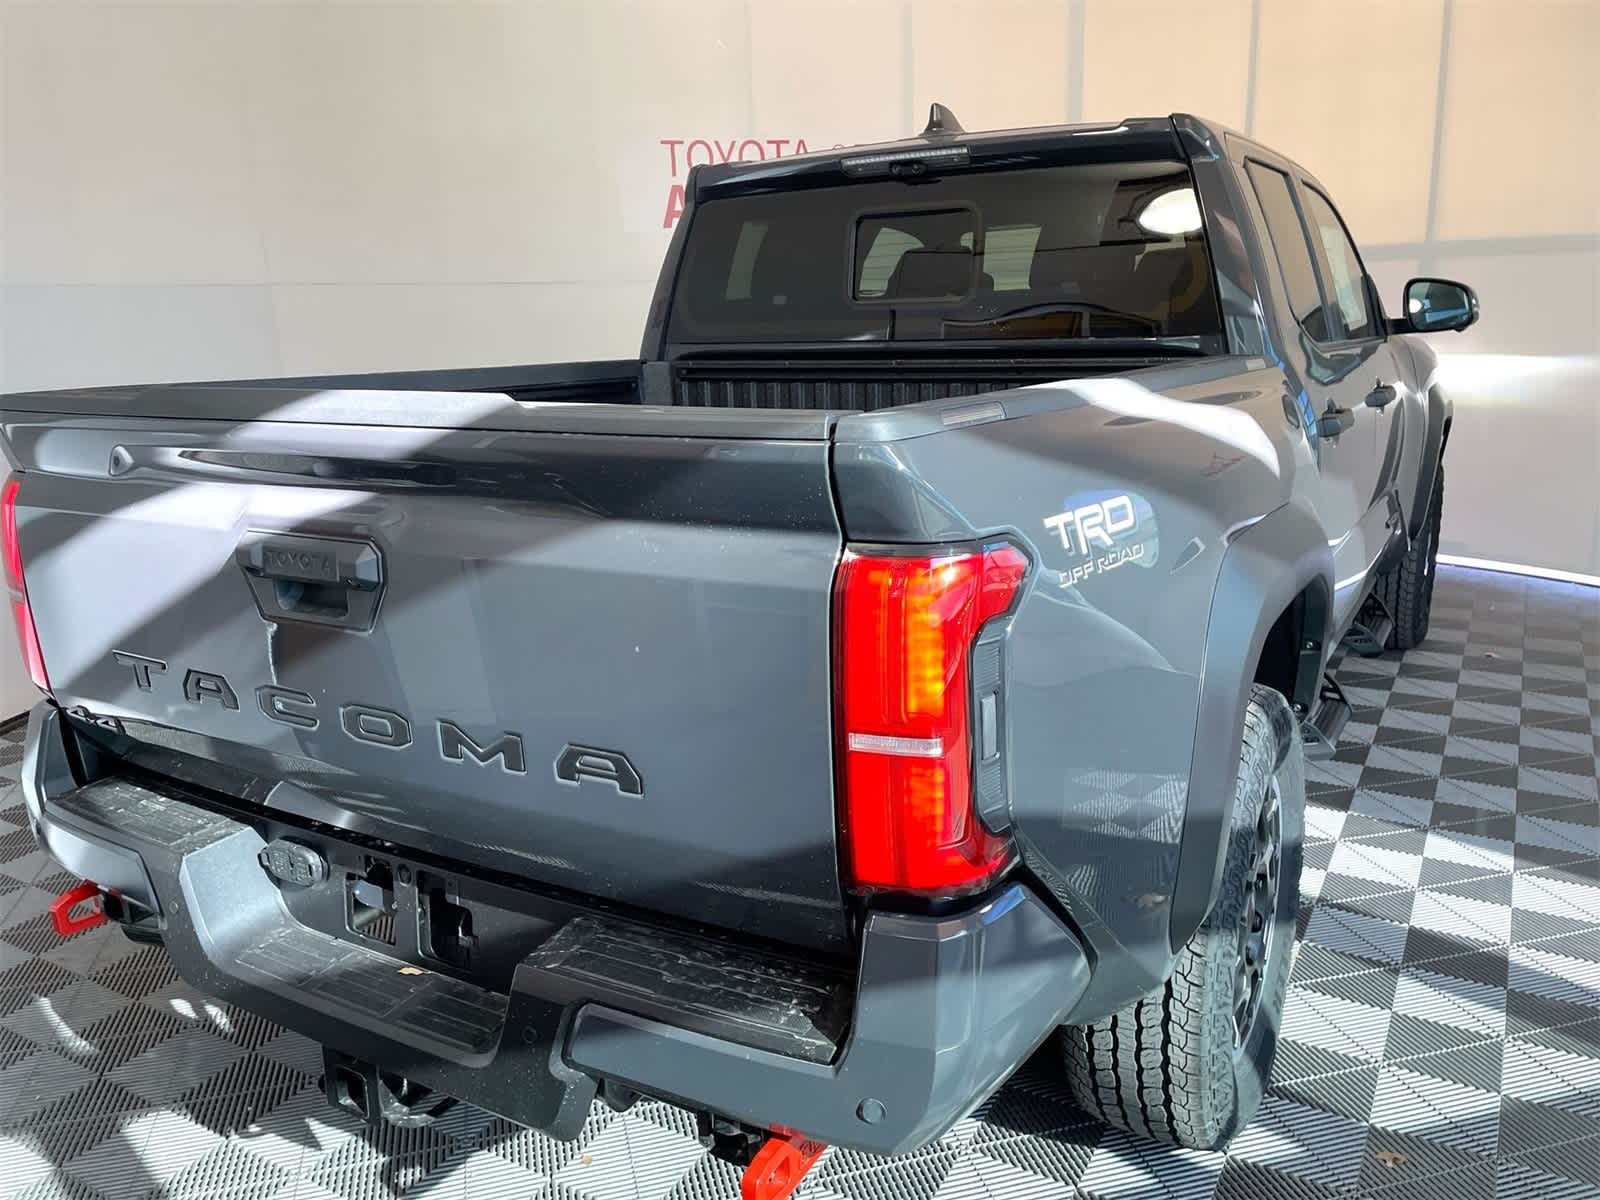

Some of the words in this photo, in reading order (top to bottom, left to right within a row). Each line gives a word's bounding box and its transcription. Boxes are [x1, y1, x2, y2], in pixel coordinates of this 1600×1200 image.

[1042, 495, 1135, 555] TRD
[264, 550, 333, 574] TOYOTA
[1058, 561, 1095, 588] OFF
[1096, 543, 1145, 574] ROAD
[112, 649, 646, 799] TACOMA
